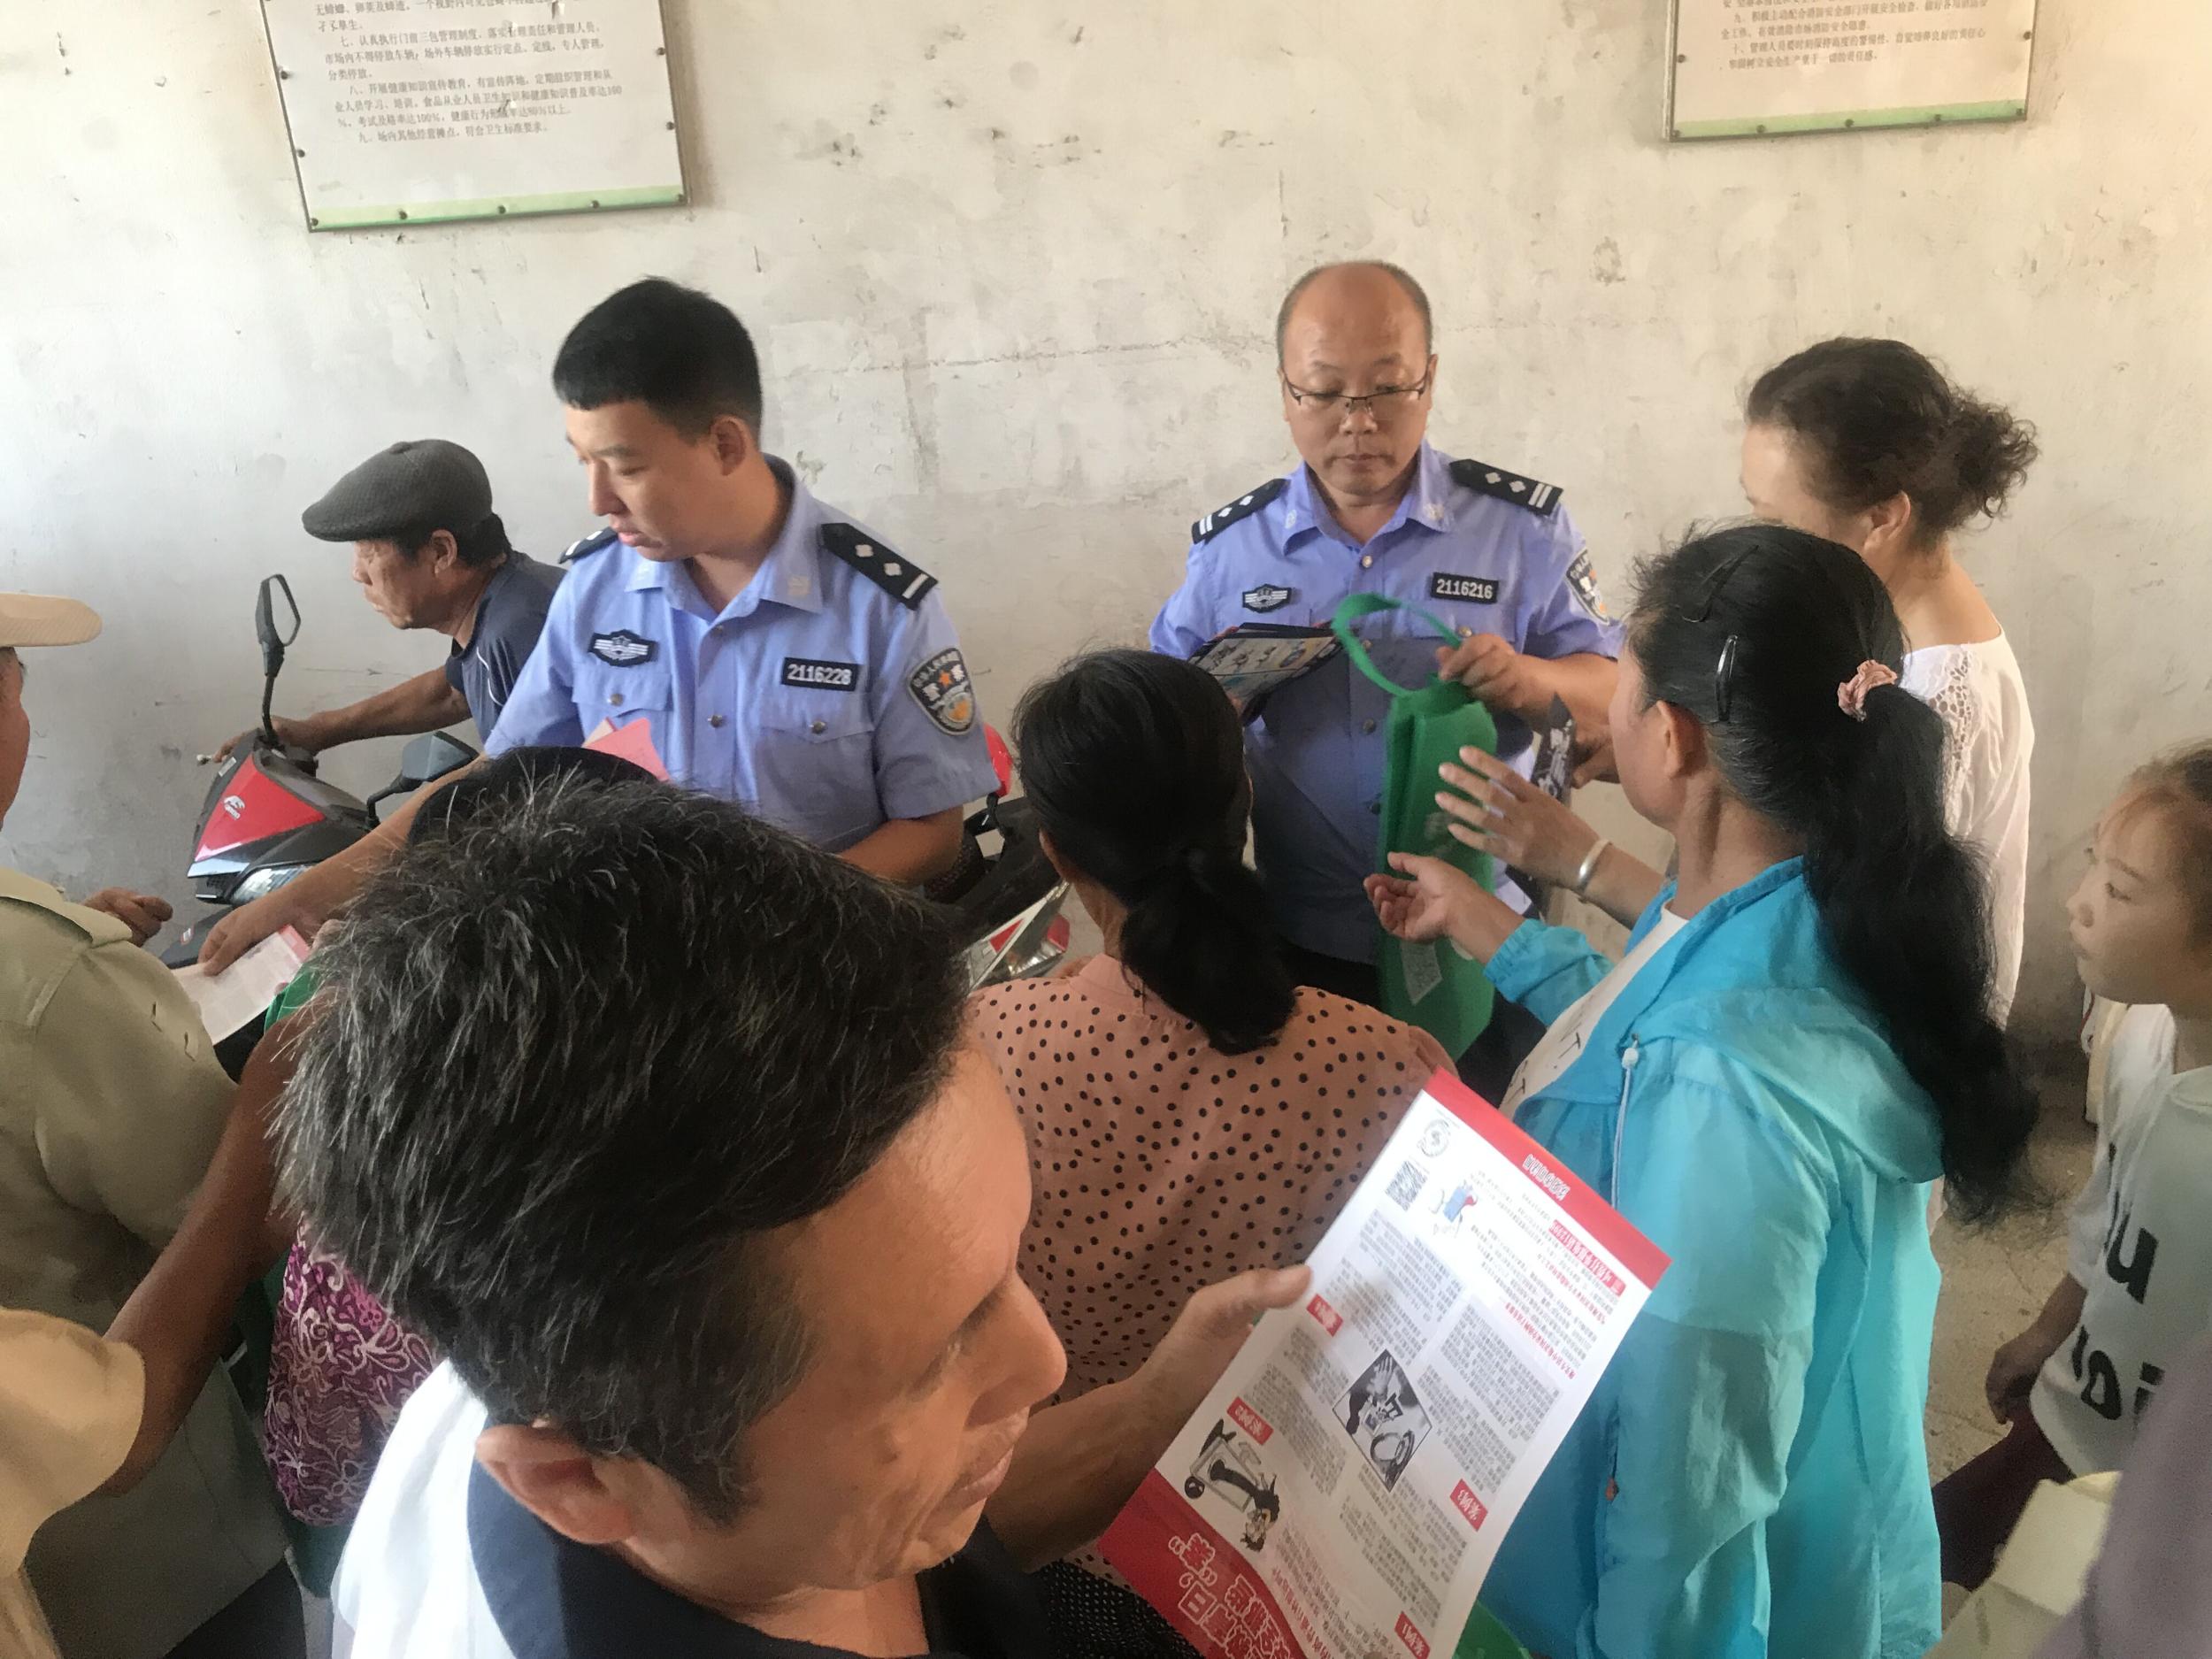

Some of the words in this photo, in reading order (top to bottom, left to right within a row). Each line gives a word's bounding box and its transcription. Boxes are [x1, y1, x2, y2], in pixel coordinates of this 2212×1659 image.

[1435, 576, 1495, 602] 2116216
[787, 662, 852, 687] 2116228
[1454, 1487, 1482, 1522] 案例3
[1396, 1619, 1427, 1658] 案例1
